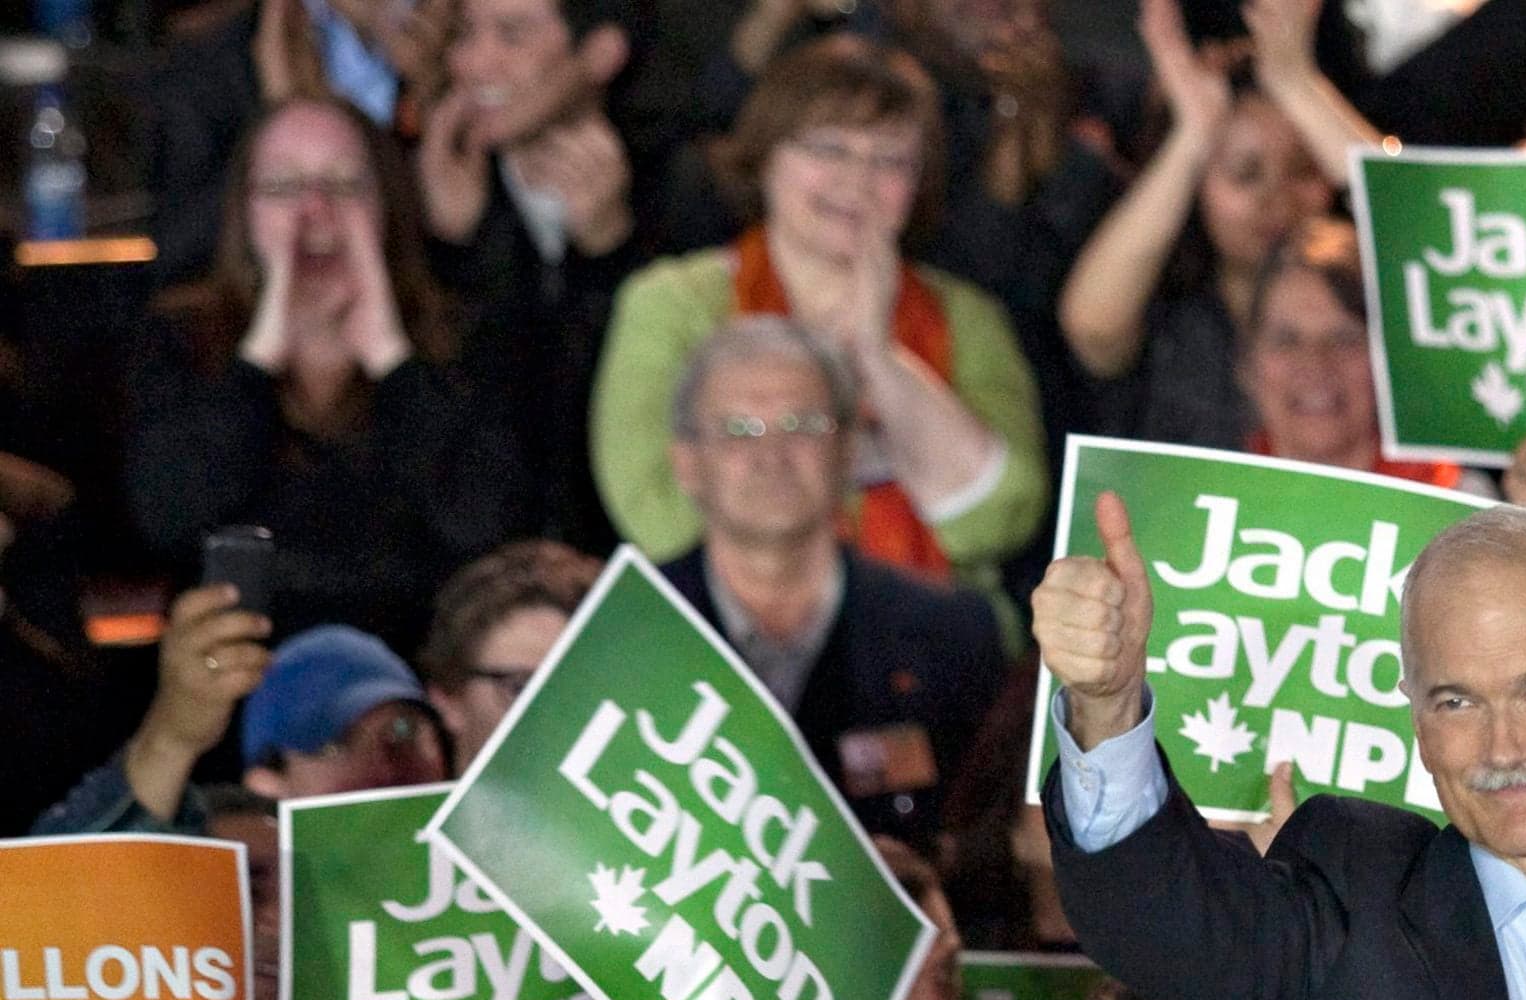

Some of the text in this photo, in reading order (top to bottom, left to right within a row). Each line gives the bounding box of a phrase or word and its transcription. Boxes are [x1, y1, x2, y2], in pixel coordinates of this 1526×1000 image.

[1152, 494, 1413, 616] Jack
[1146, 609, 1411, 708] ayto
[635, 681, 833, 928] Jack
